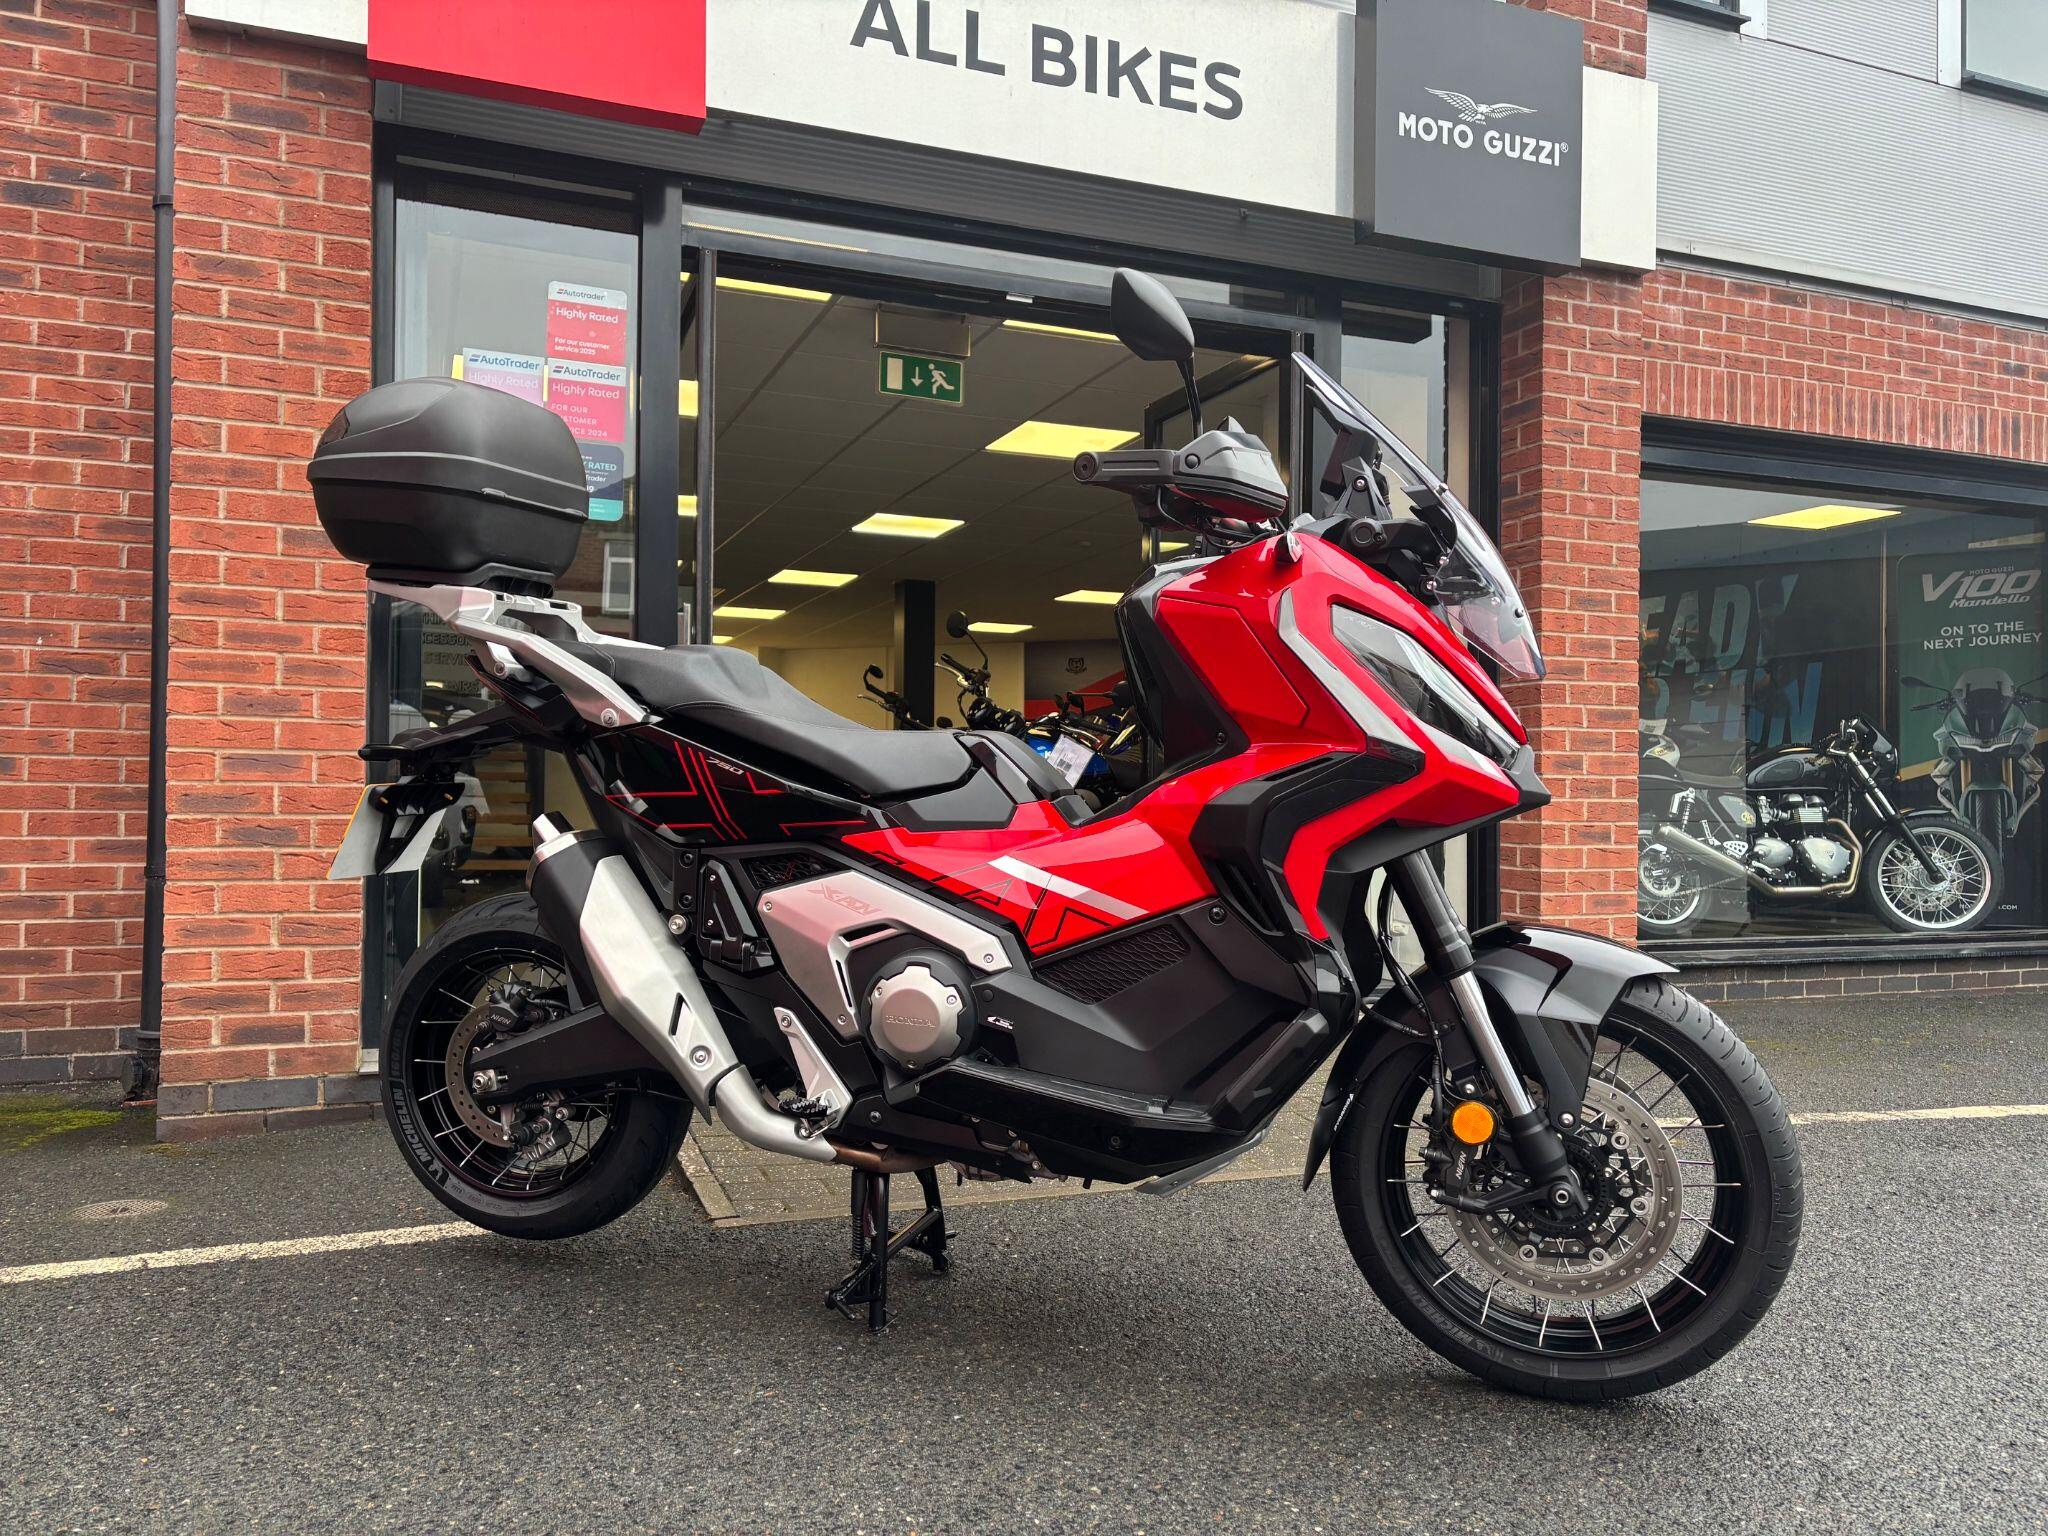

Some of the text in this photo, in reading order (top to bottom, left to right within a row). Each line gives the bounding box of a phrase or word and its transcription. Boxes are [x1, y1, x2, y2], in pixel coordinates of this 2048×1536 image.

[850, 0, 1244, 121] ALL BIKES
[1398, 111, 1474, 149] MOTO
[555, 307, 619, 323] Highly Rated
[554, 336, 566, 344] For
[579, 341, 610, 350] customer
[554, 345, 578, 353] service
[480, 355, 540, 370] AutoTrader
[468, 370, 538, 389] Highly Rated
[563, 366, 621, 382] AutoTrader
[552, 383, 620, 399] Highly Rated
[551, 403, 588, 413] FOR OUR
[561, 415, 598, 425] STOMER
[588, 462, 617, 471] RATED
[585, 474, 607, 482] Trader
[1969, 565, 2015, 576] MOTO GUZZI
[1922, 569, 2042, 602] V100
[1948, 594, 2031, 609] Mandello
[1639, 574, 1799, 686] EADY
[1941, 621, 2025, 637] ON TO THE
[1923, 632, 2042, 650] NEXT JOURNEY
[706, 756, 744, 775] 750
[393, 1087, 433, 1164] MICHELIN
